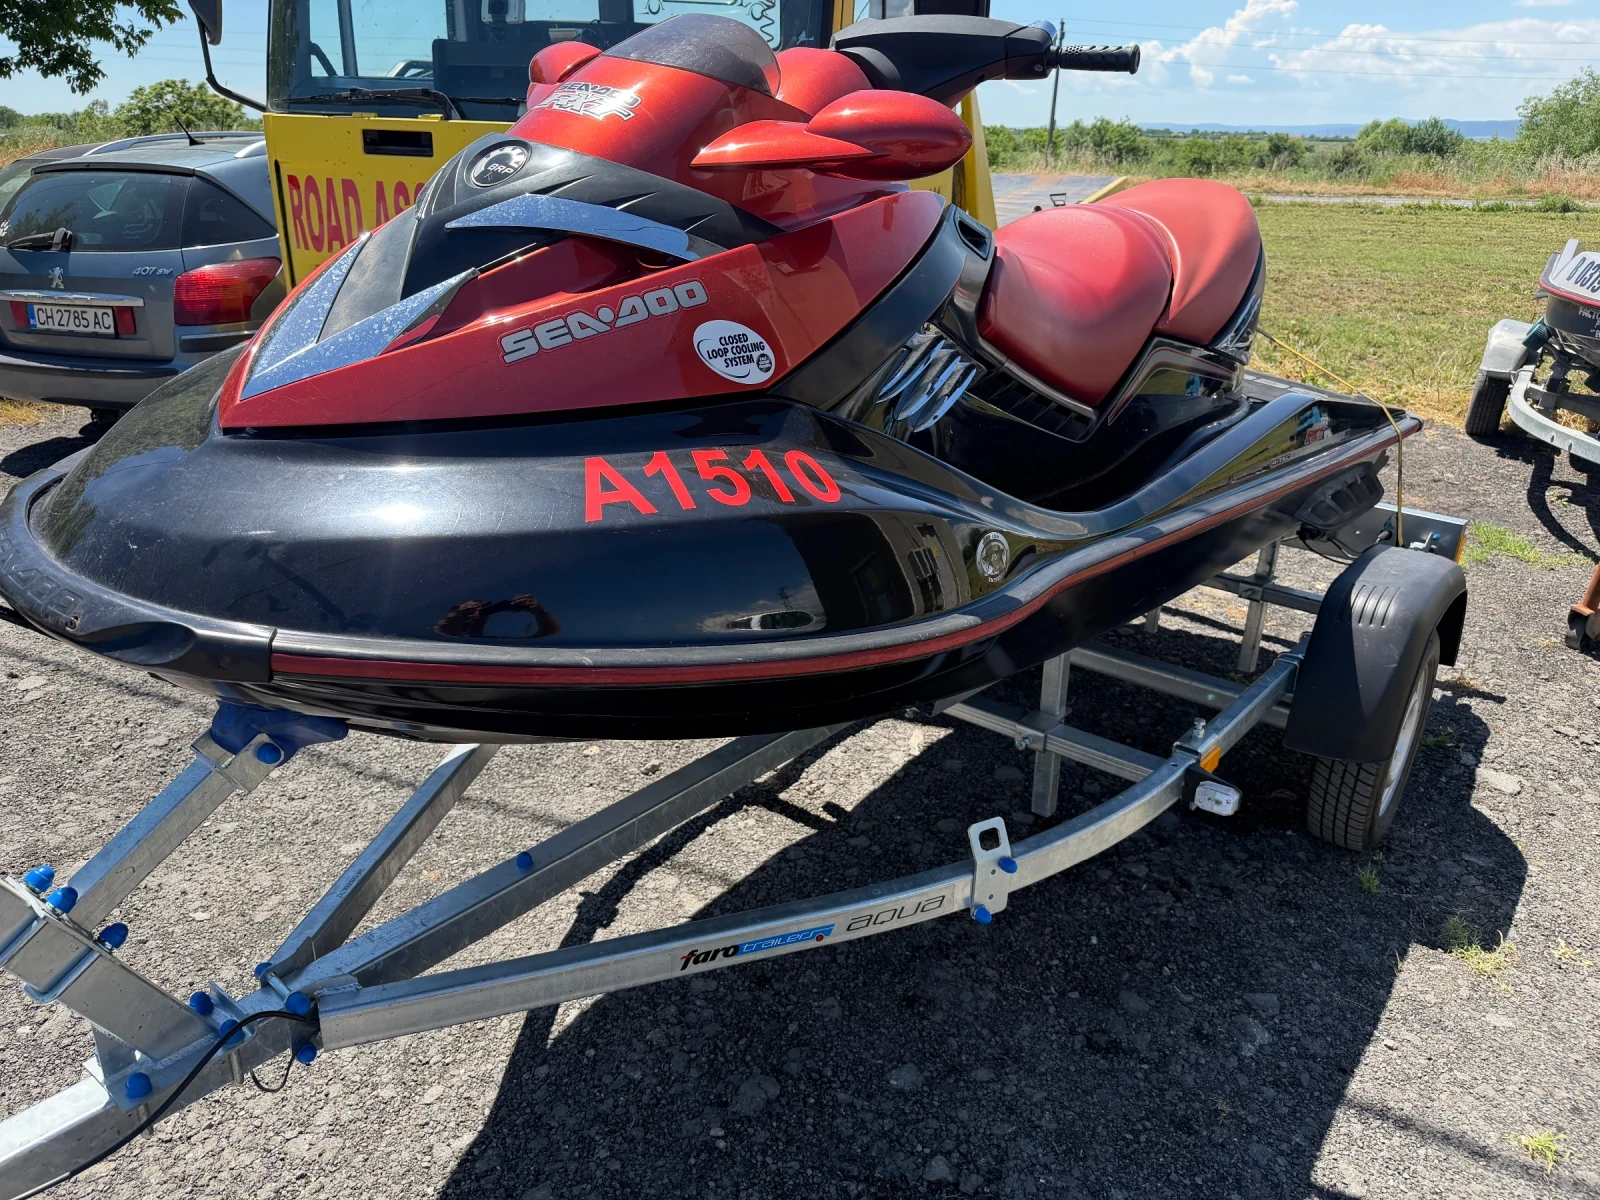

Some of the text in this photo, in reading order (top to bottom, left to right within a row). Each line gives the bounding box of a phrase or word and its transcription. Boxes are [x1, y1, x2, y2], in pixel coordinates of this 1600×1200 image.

[487, 162, 514, 174] BRP
[287, 174, 364, 253] ROAD
[132, 266, 158, 276] 407
[36, 307, 112, 330] CH 2785 AC
[718, 333, 749, 347] CLOSED
[706, 341, 766, 360] LOOP COOLING
[723, 354, 755, 368] SYSTEM
[584, 449, 842, 523] A1510
[680, 894, 946, 972] faro trailers aqua
